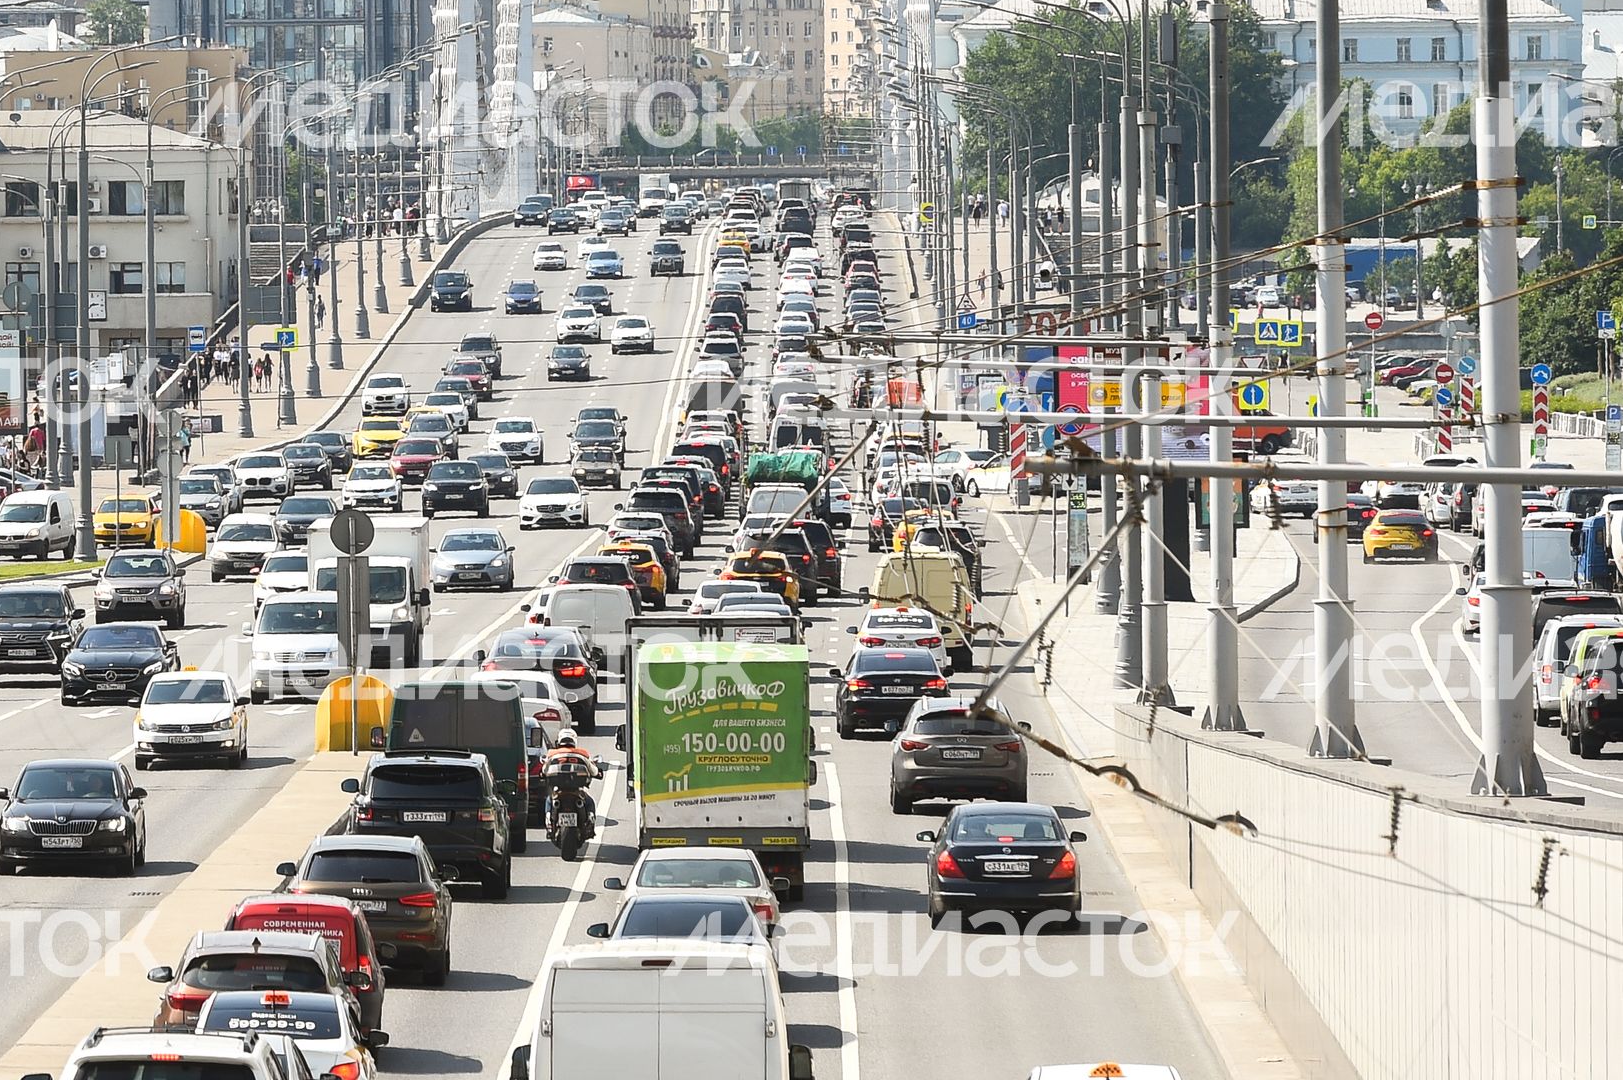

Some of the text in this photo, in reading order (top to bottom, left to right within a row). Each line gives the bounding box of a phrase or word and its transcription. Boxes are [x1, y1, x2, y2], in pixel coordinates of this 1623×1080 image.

[961, 316, 972, 326] 40
[713, 719, 786, 728] ДЛЯ ВАШЕГО БИЗНЕСА
[663, 732, 786, 755] (495) 150-00-00
[698, 755, 769, 763] КРУГЛОСУТОЧНО
[674, 799, 699, 807] СРОЧНЫЙ
[718, 795, 742, 803] МАШИНЫ
[263, 920, 326, 928] СОВРЕМЕННАЯ
